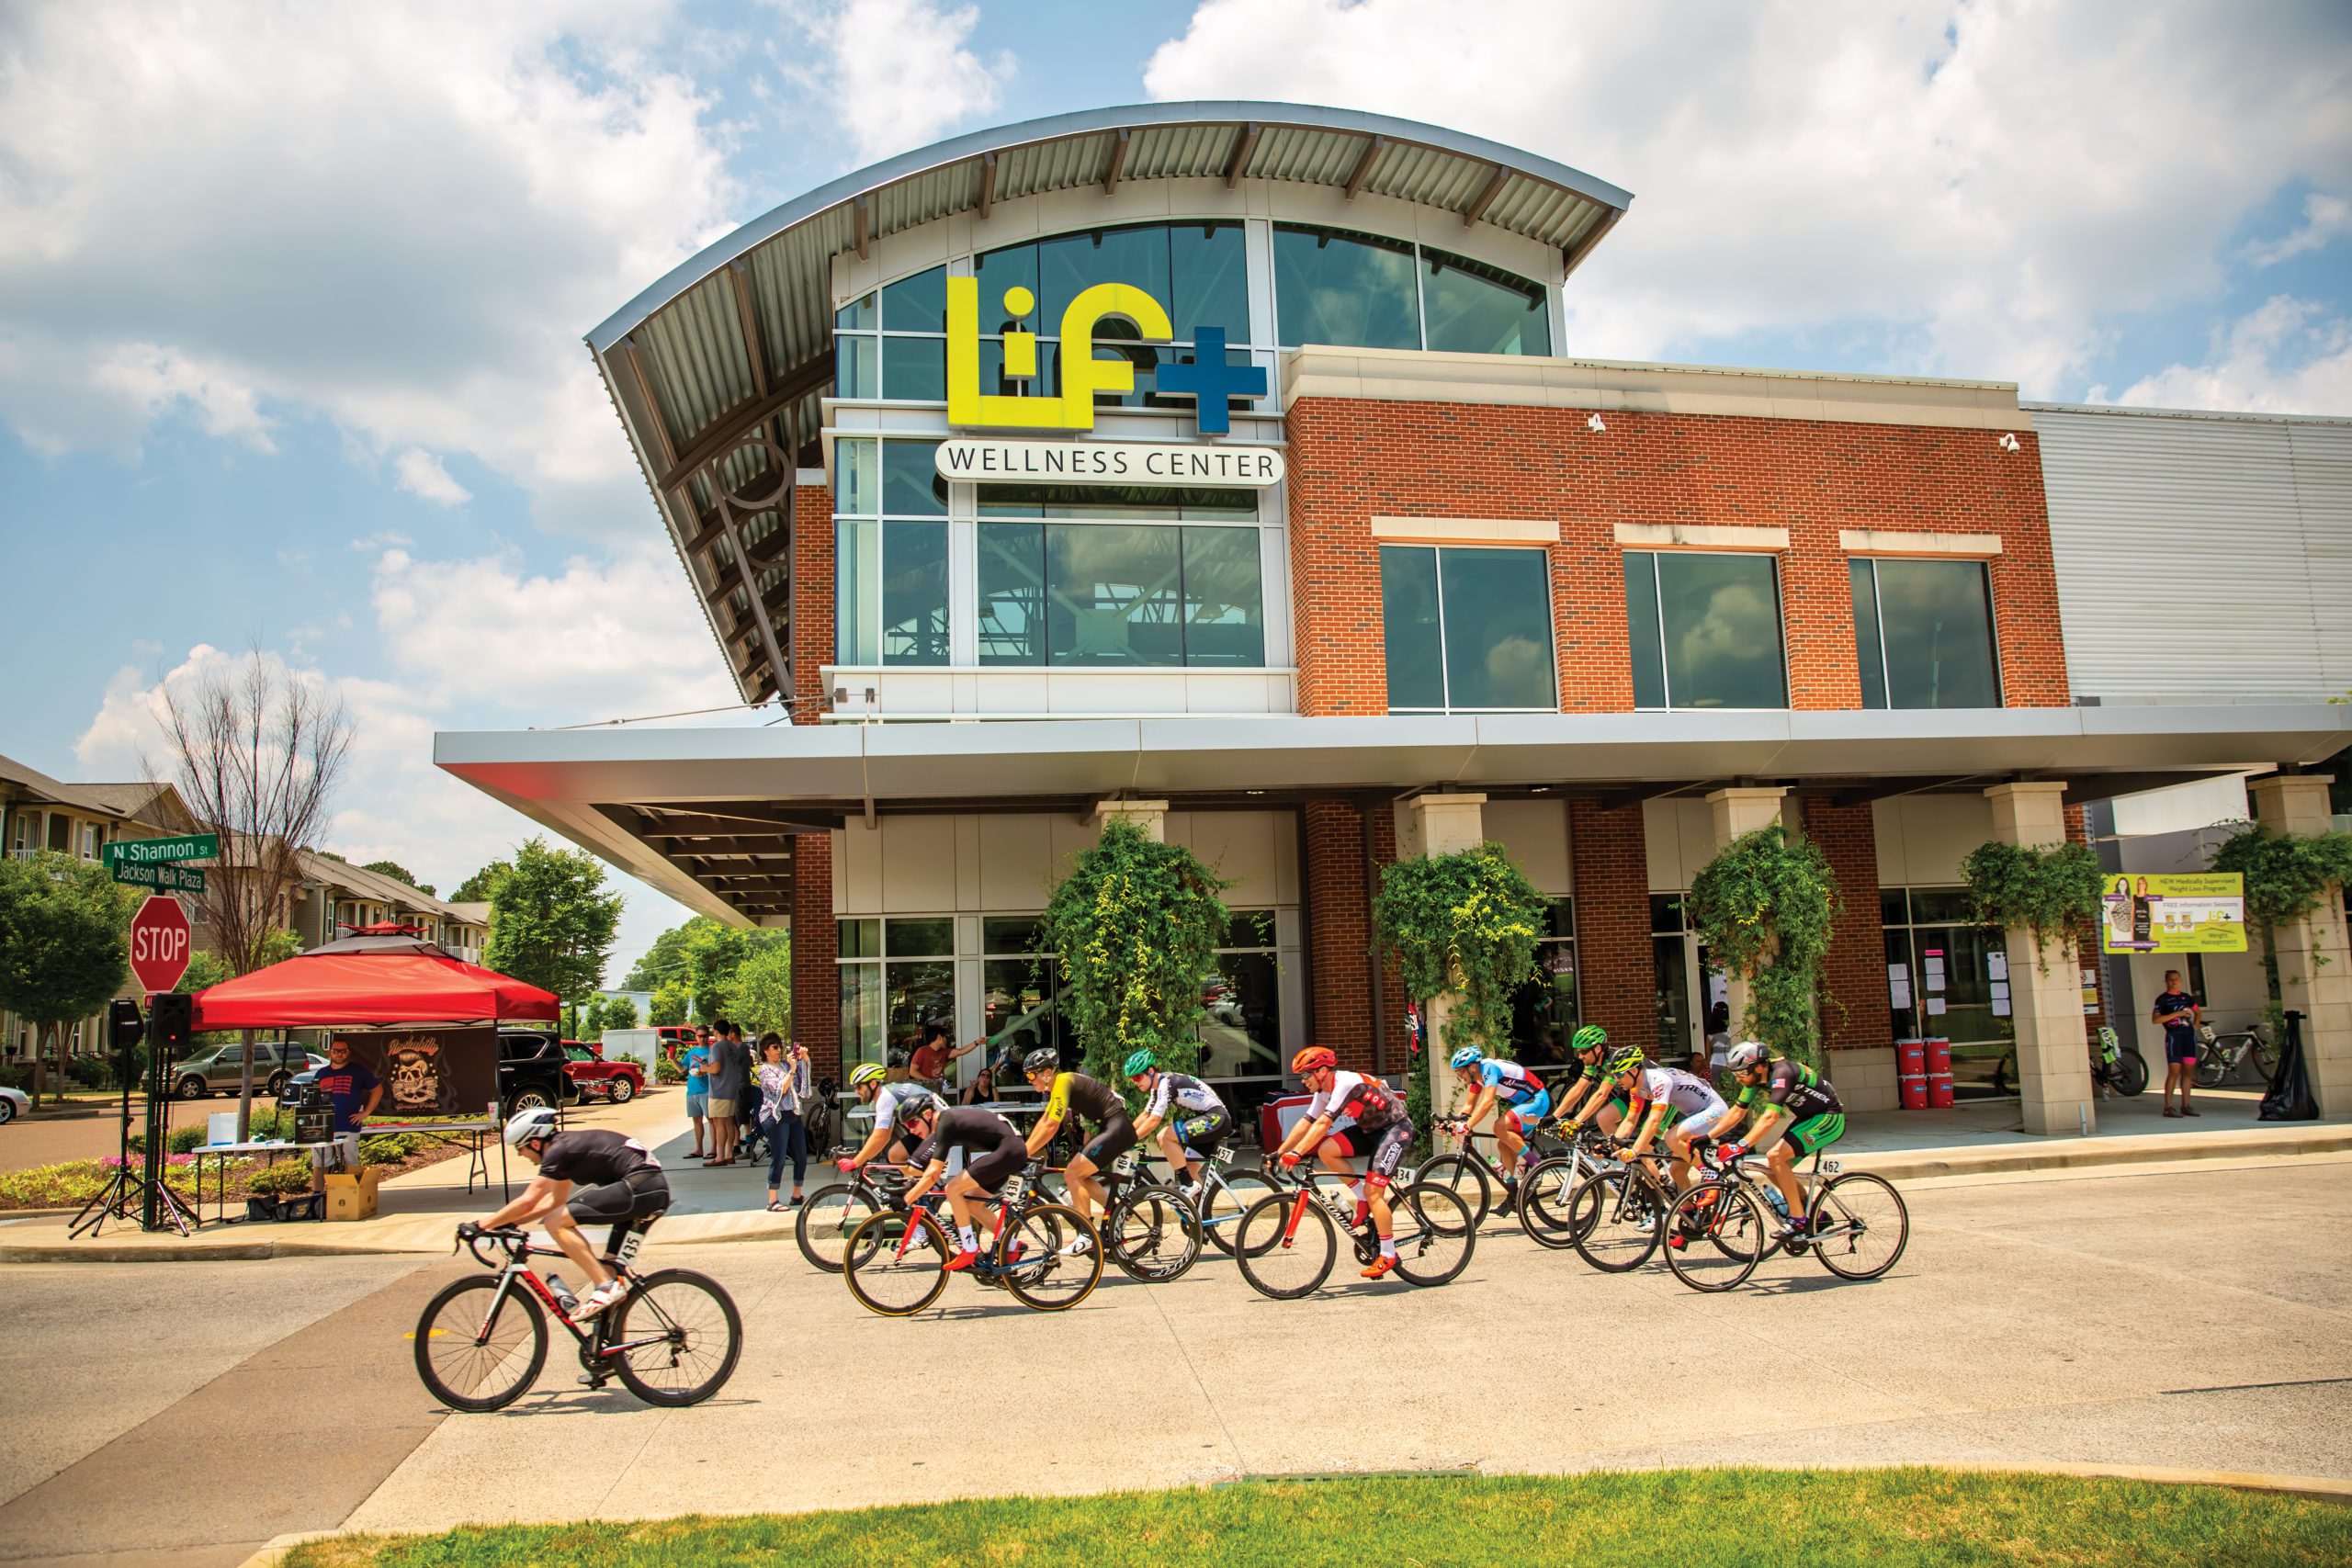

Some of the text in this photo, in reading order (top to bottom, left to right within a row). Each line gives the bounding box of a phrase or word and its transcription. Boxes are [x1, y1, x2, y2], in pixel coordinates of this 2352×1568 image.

[947, 446, 1275, 478] WELLNESS CENTER
[113, 842, 209, 862] N Shannon St
[118, 861, 201, 888] Jackson Walk Plaza
[2176, 877, 2203, 886] Medically
[2203, 885, 2227, 893] Program
[135, 926, 187, 962] STOP
[1363, 1091, 1385, 1110] HOT
[1676, 1084, 1709, 1100] TREK
[1804, 1087, 1831, 1104] TREK
[1117, 1155, 1130, 1170] 464
[1822, 1161, 1839, 1173] 462
[1005, 1179, 1020, 1198] 438
[1746, 1180, 1780, 1217] MERCKX
[1317, 1192, 1358, 1237] SPECIALIZED
[623, 1236, 640, 1261] 435
